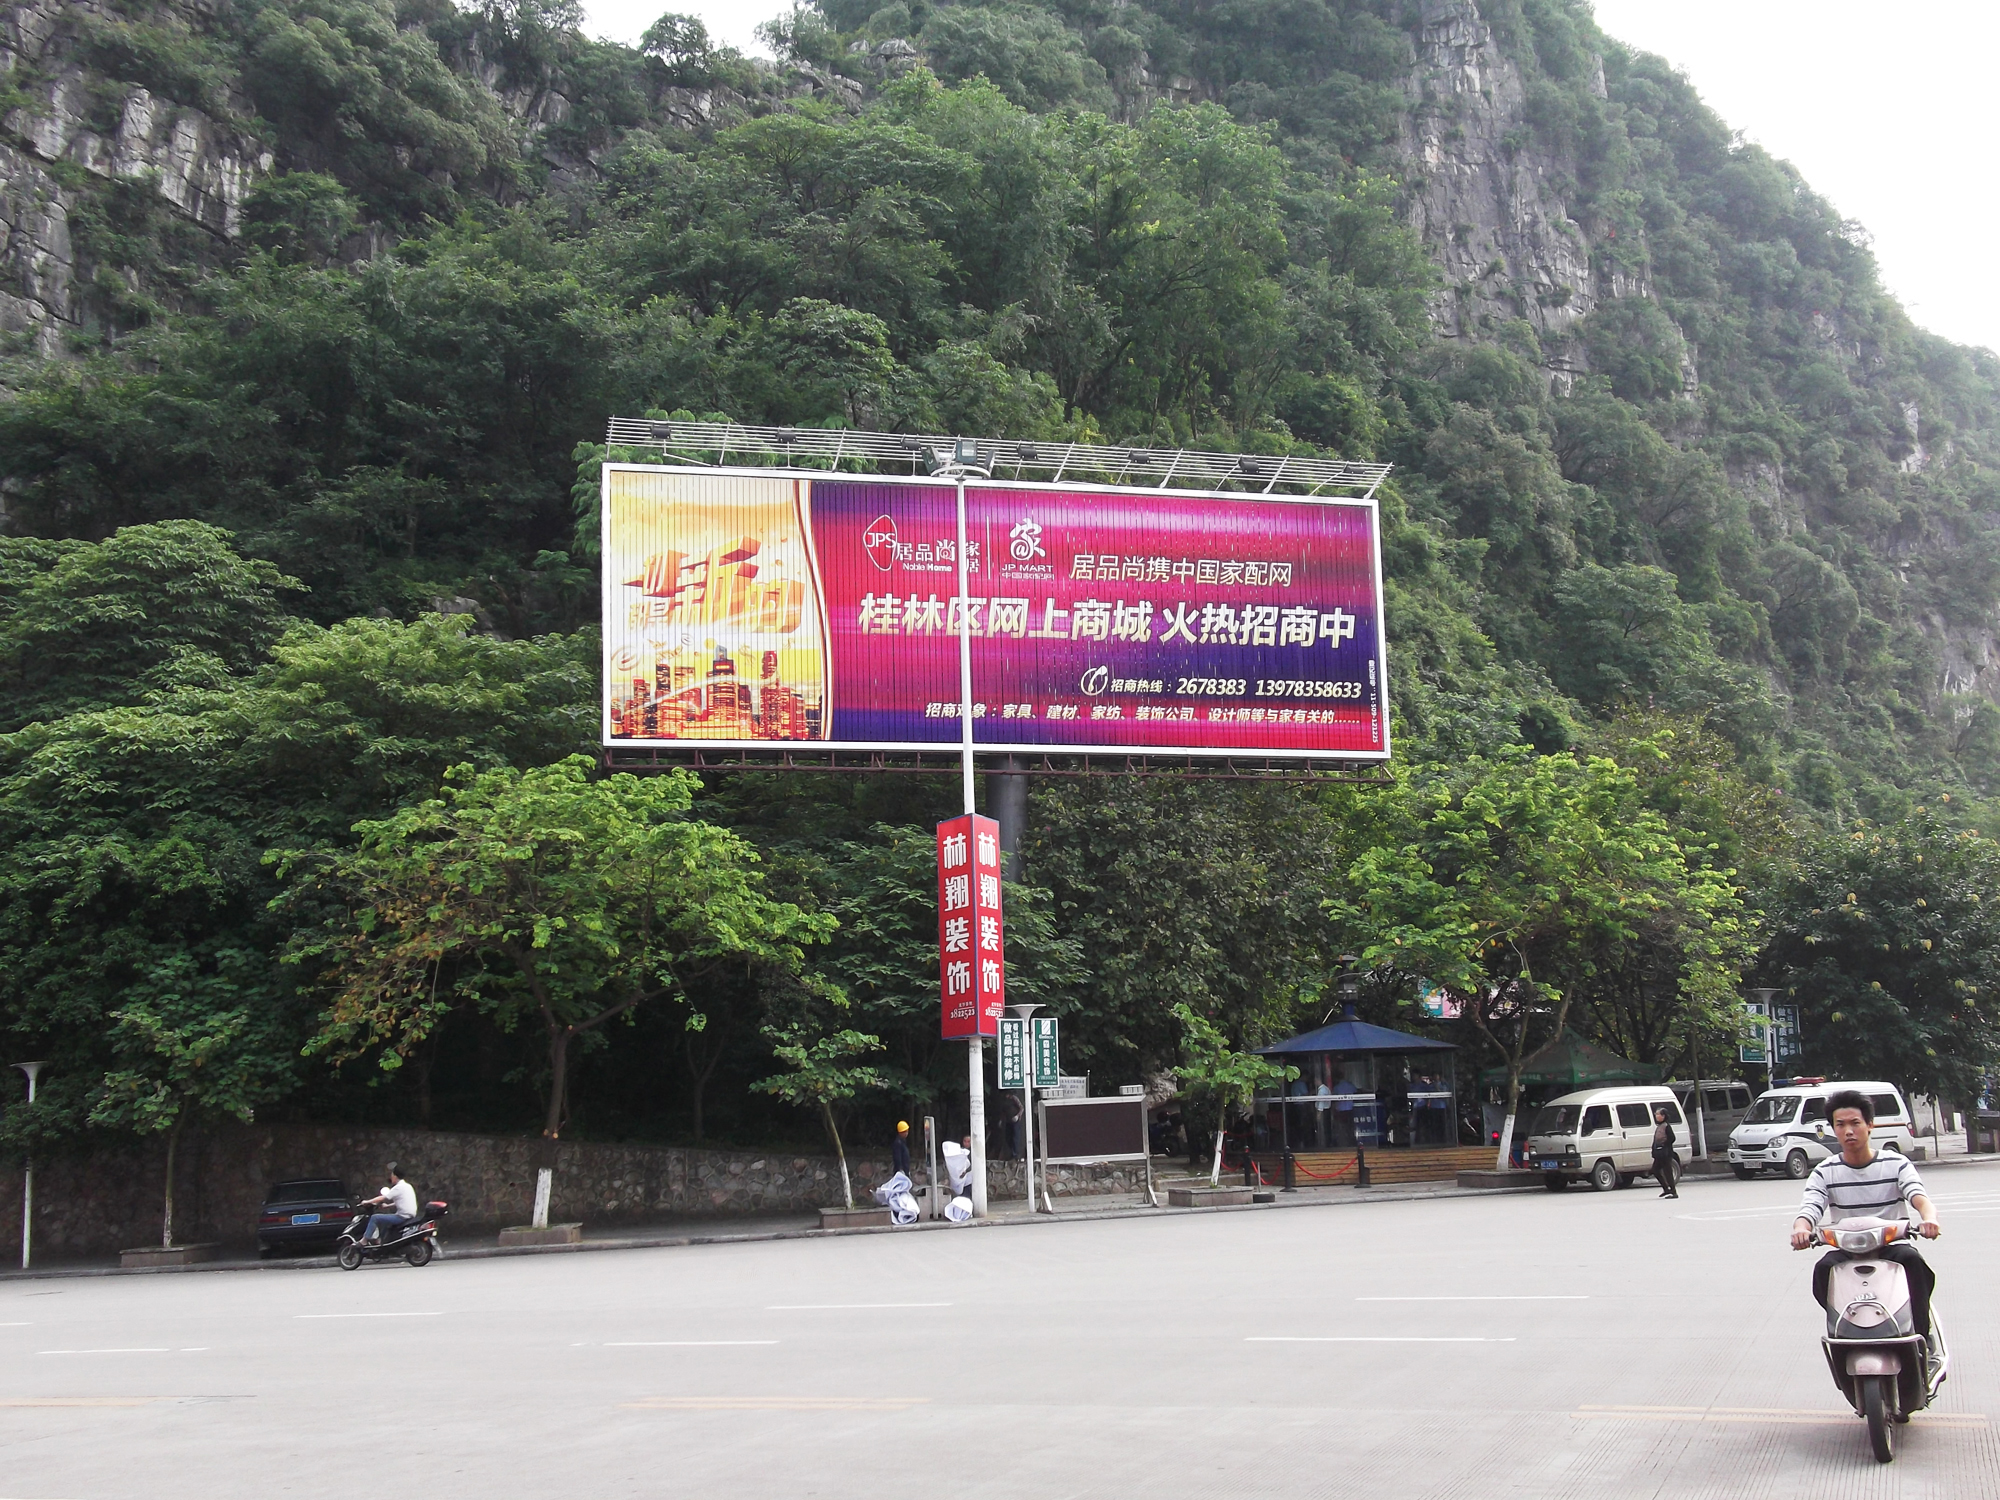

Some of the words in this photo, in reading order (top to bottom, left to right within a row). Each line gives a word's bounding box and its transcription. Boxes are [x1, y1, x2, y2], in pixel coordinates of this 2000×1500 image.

[867, 532, 897, 549] JPS
[927, 562, 953, 572] Home
[1001, 563, 1016, 572] JP
[1019, 564, 1054, 573] MART
[1069, 554, 1293, 588] 居品尚携中国家配网
[859, 592, 1154, 642] 桂林区网上商城
[1159, 601, 1356, 648] 火热招商中
[1176, 676, 1247, 696] 2678383
[1254, 678, 1363, 699] 13978358633
[942, 832, 971, 996] 林翔装饰
[978, 832, 1000, 994] 林翔装饰
